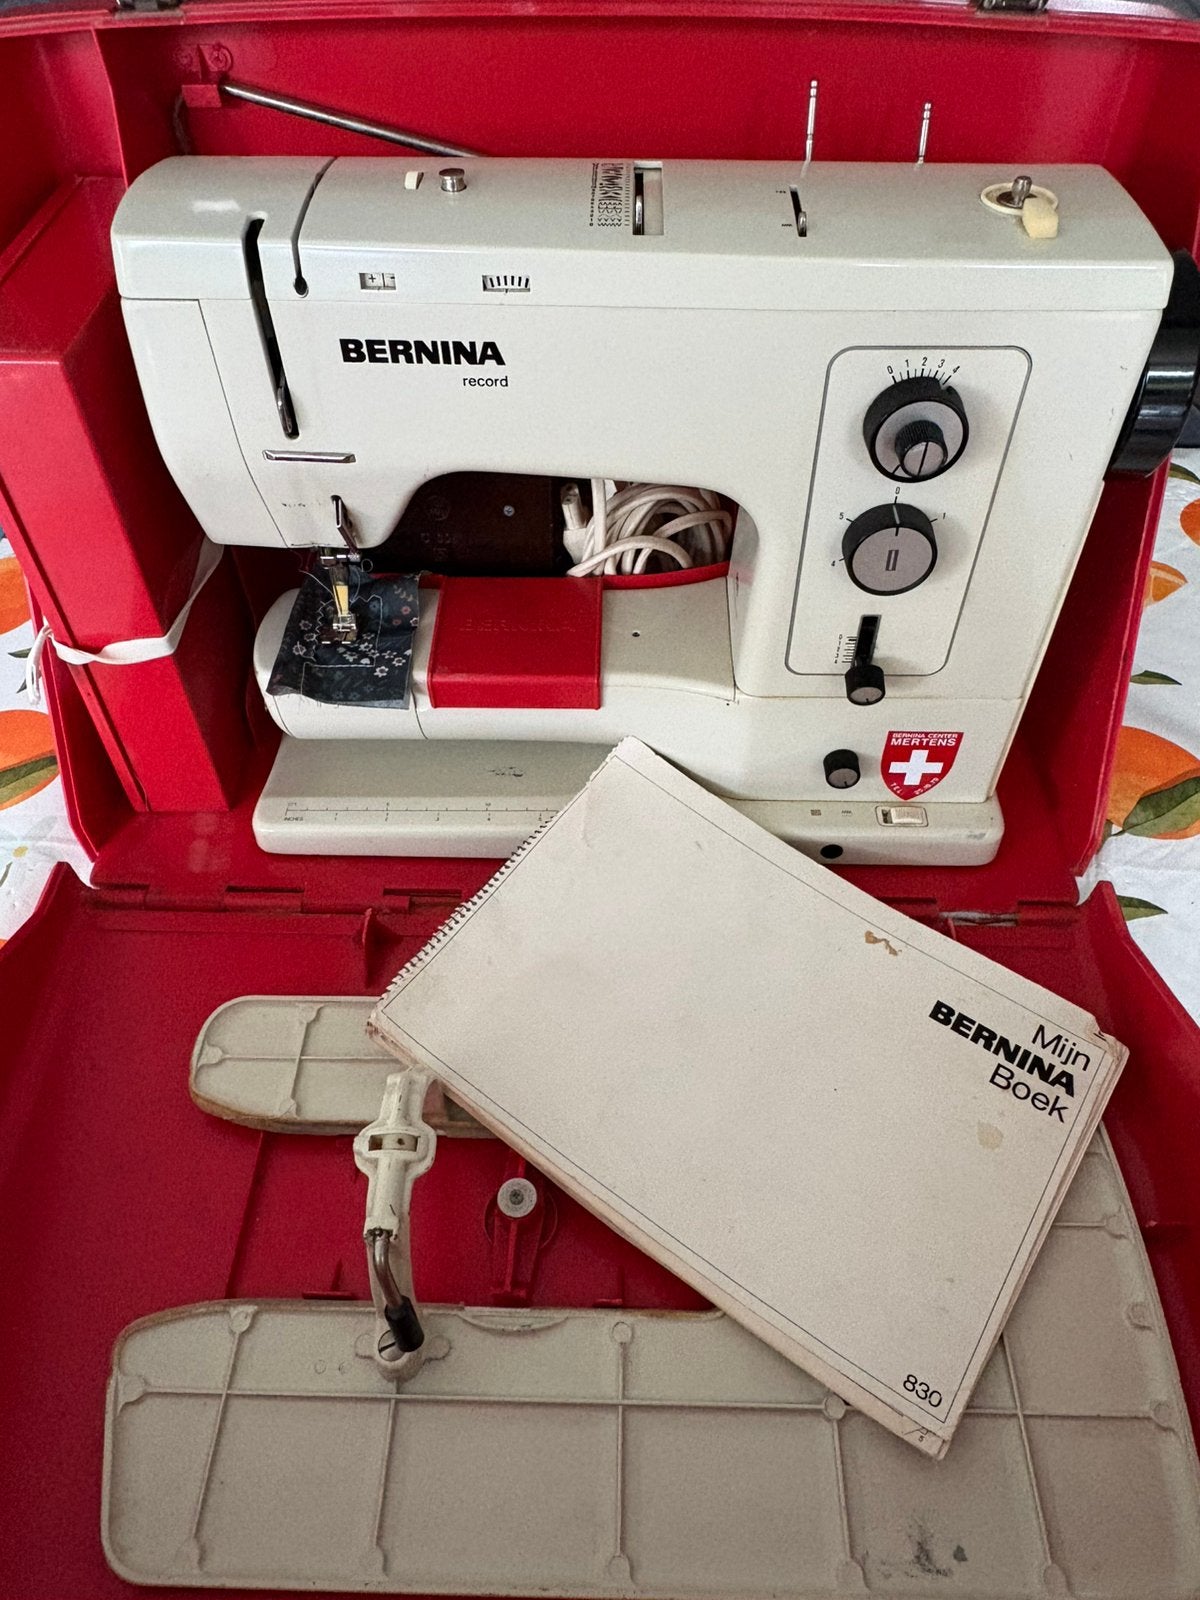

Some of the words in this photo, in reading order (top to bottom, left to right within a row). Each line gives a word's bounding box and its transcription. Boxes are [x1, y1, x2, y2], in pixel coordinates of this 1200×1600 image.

[339, 338, 506, 366] BERNINA
[886, 365, 894, 375] 0
[905, 359, 909, 368] 1
[922, 356, 928, 367] 2
[937, 359, 945, 369] 3
[952, 365, 960, 375] 4
[463, 376, 509, 388] record
[895, 486, 901, 495] 0
[839, 512, 844, 520] 5
[942, 512, 947, 520] 1
[890, 738, 957, 747] MERTENS
[928, 1000, 1075, 1098] BERNINA
[1031, 1024, 1091, 1072] Mijn
[989, 1063, 1068, 1123] Boek
[903, 1374, 943, 1408] 830
